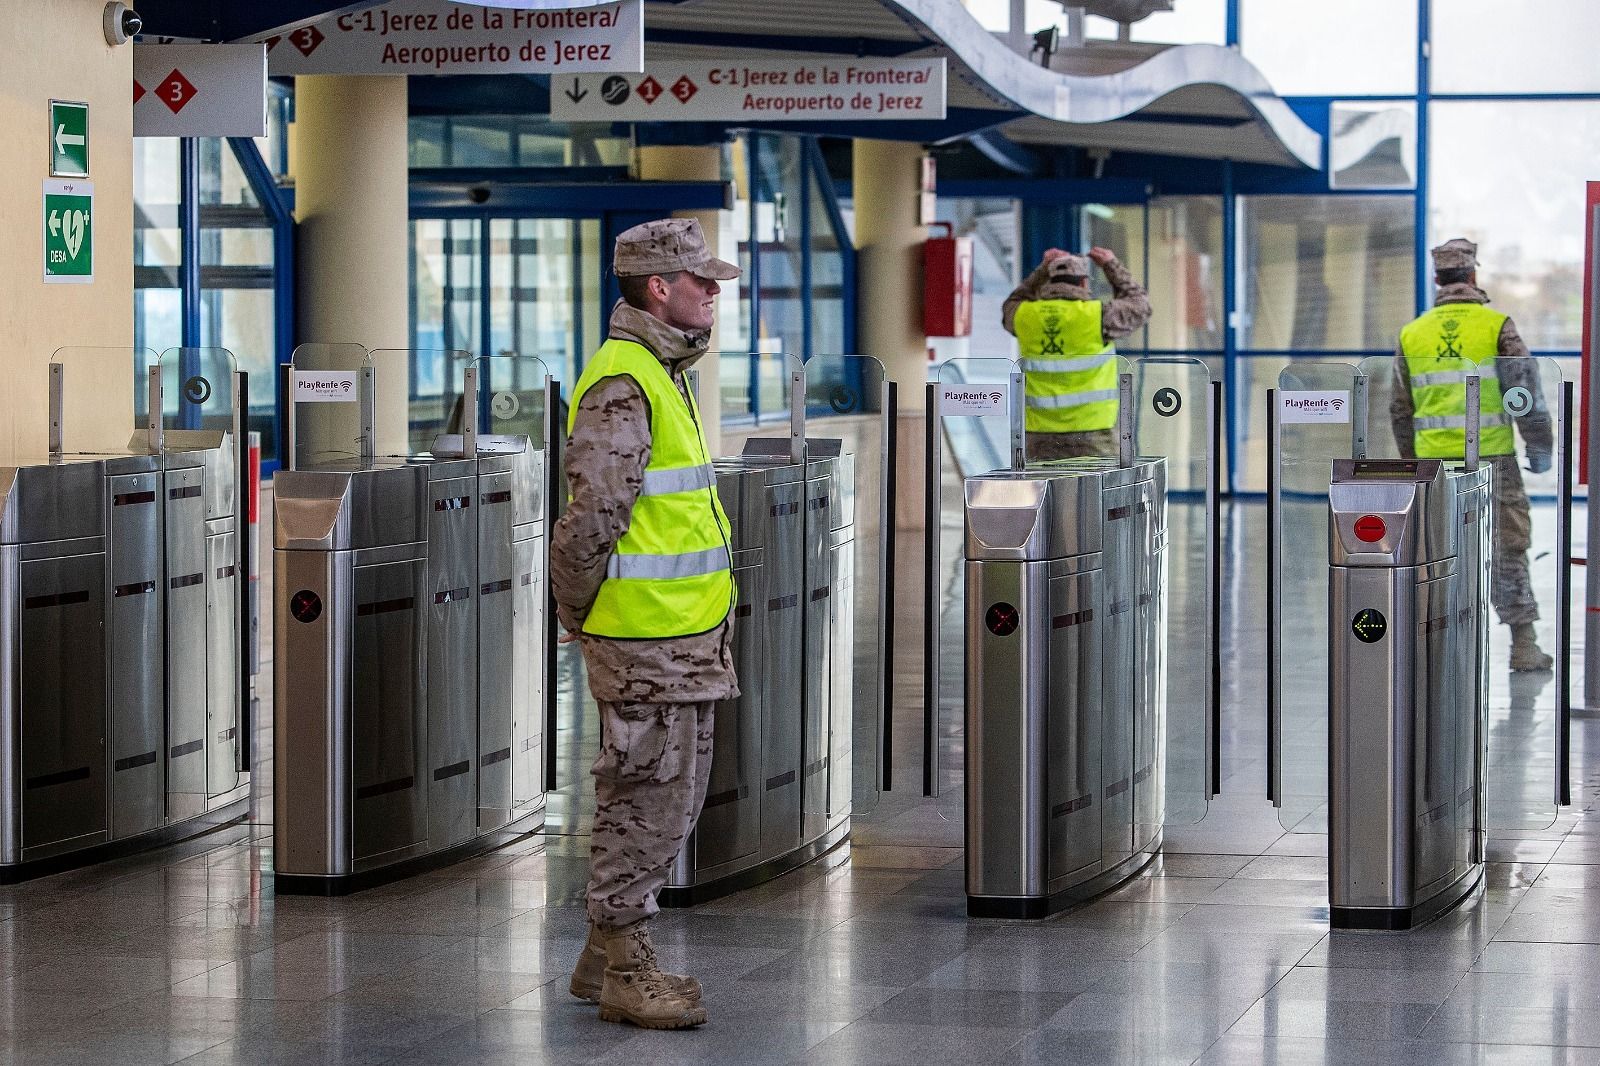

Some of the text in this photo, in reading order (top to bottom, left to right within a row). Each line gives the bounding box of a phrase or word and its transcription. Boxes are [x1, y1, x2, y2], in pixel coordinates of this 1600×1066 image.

[337, 5, 621, 35] C-1 Jerez de la Frontera/
[300, 28, 313, 48] 3
[381, 39, 611, 68] Aeropuerto de Jerez
[708, 66, 932, 88] C-1 Jerez de la Frontera/
[170, 81, 183, 102] 3
[643, 82, 655, 99] 1
[679, 82, 690, 99] 3
[743, 92, 923, 114] Aeropuerto de Jerez
[50, 250, 67, 263] DESA
[298, 380, 339, 390] PlayRenfe
[944, 391, 988, 401] PlayRenfe
[1285, 399, 1329, 408] PlayRenfe
